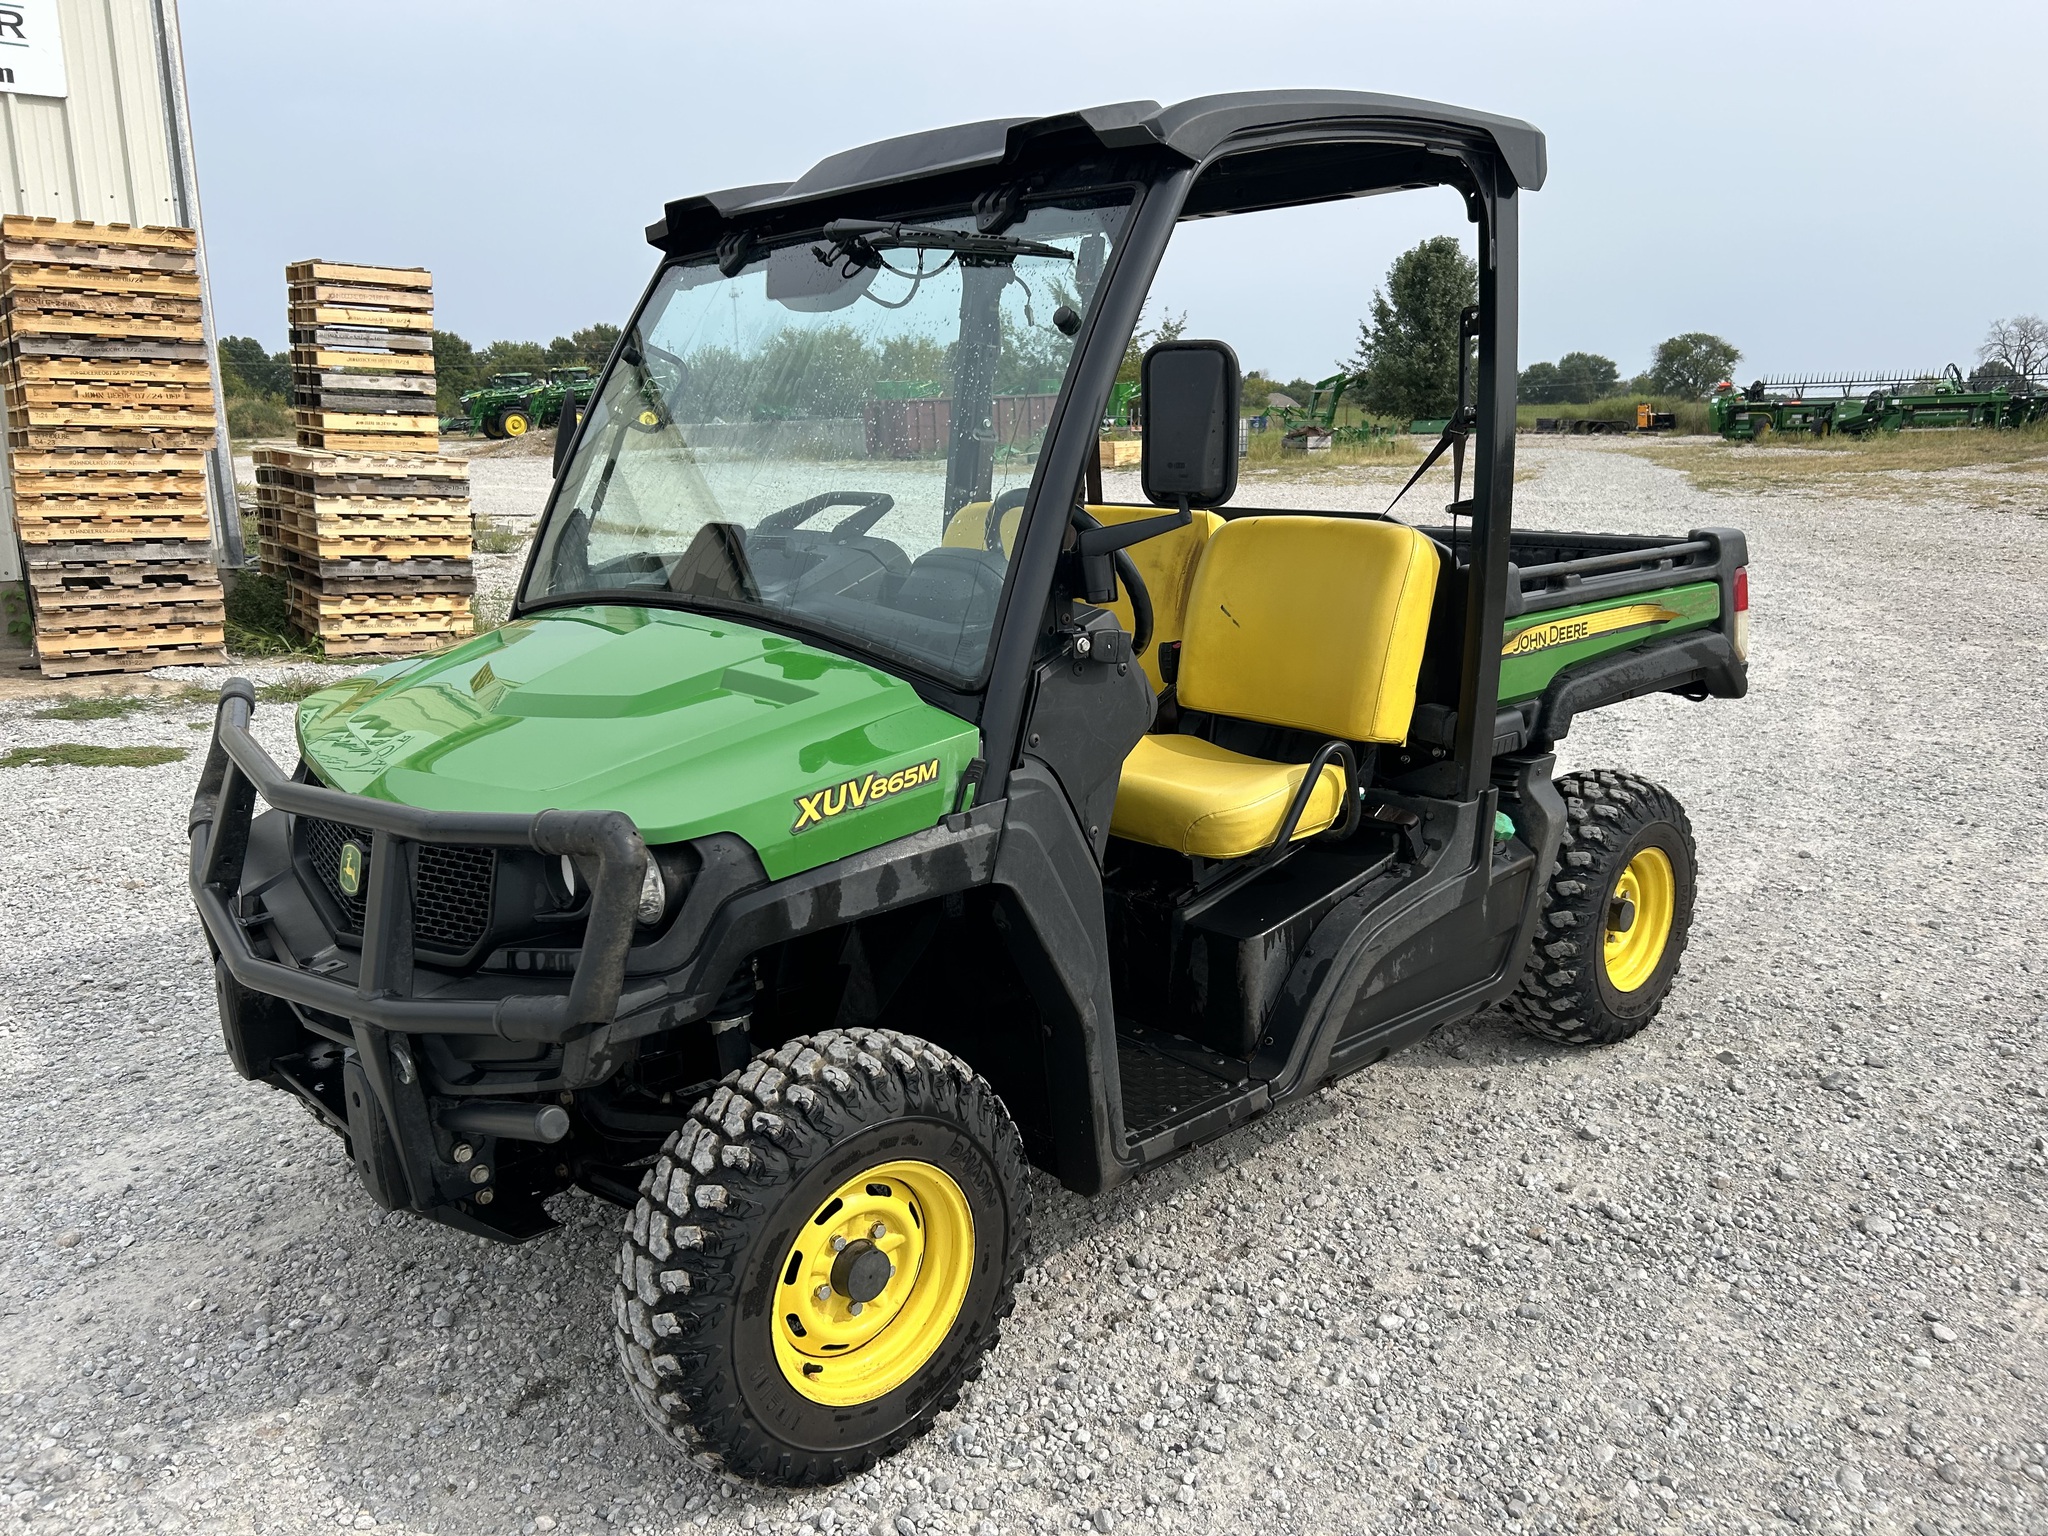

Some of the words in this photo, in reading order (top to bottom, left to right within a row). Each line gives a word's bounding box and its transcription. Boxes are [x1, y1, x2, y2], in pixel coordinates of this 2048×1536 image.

[82, 391, 104, 399] JOHN
[107, 392, 132, 400] DEERE
[134, 392, 163, 400] 07/24
[1514, 630, 1547, 652] JOHN
[1549, 622, 1589, 644] DEERE
